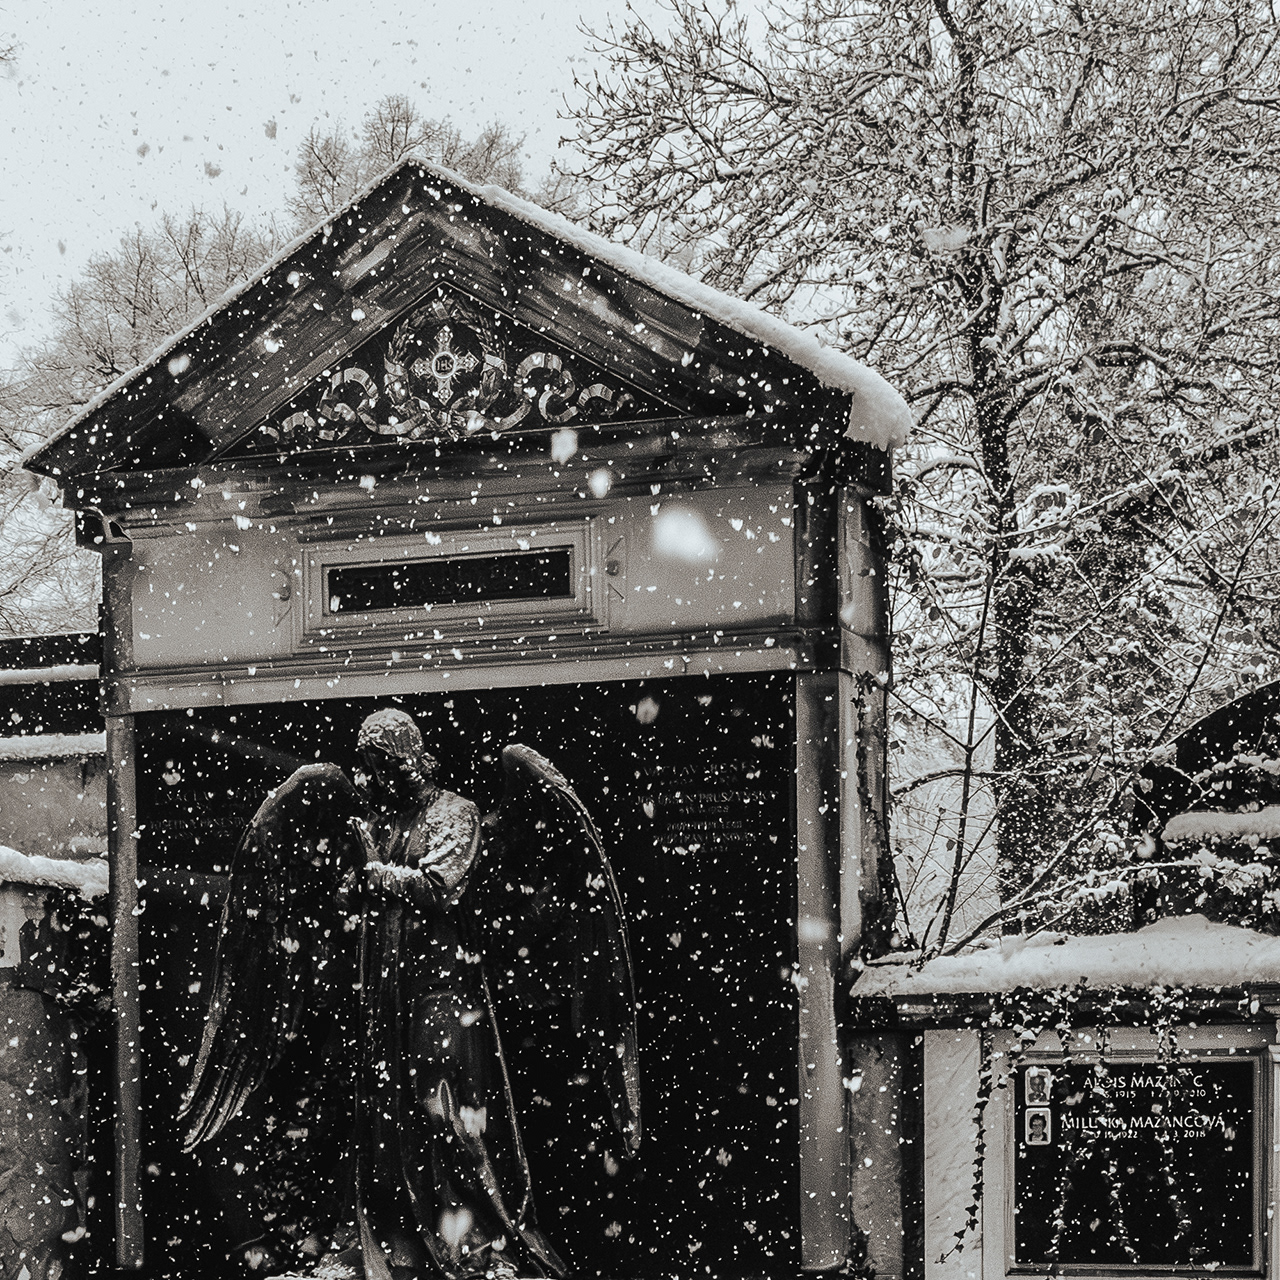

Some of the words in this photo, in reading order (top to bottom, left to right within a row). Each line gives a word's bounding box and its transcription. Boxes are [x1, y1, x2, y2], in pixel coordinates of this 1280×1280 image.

[1130, 1074, 1204, 1088] MAZNC
[1115, 1090, 1137, 1099] 1915
[1183, 1130, 1206, 1138] 2018
